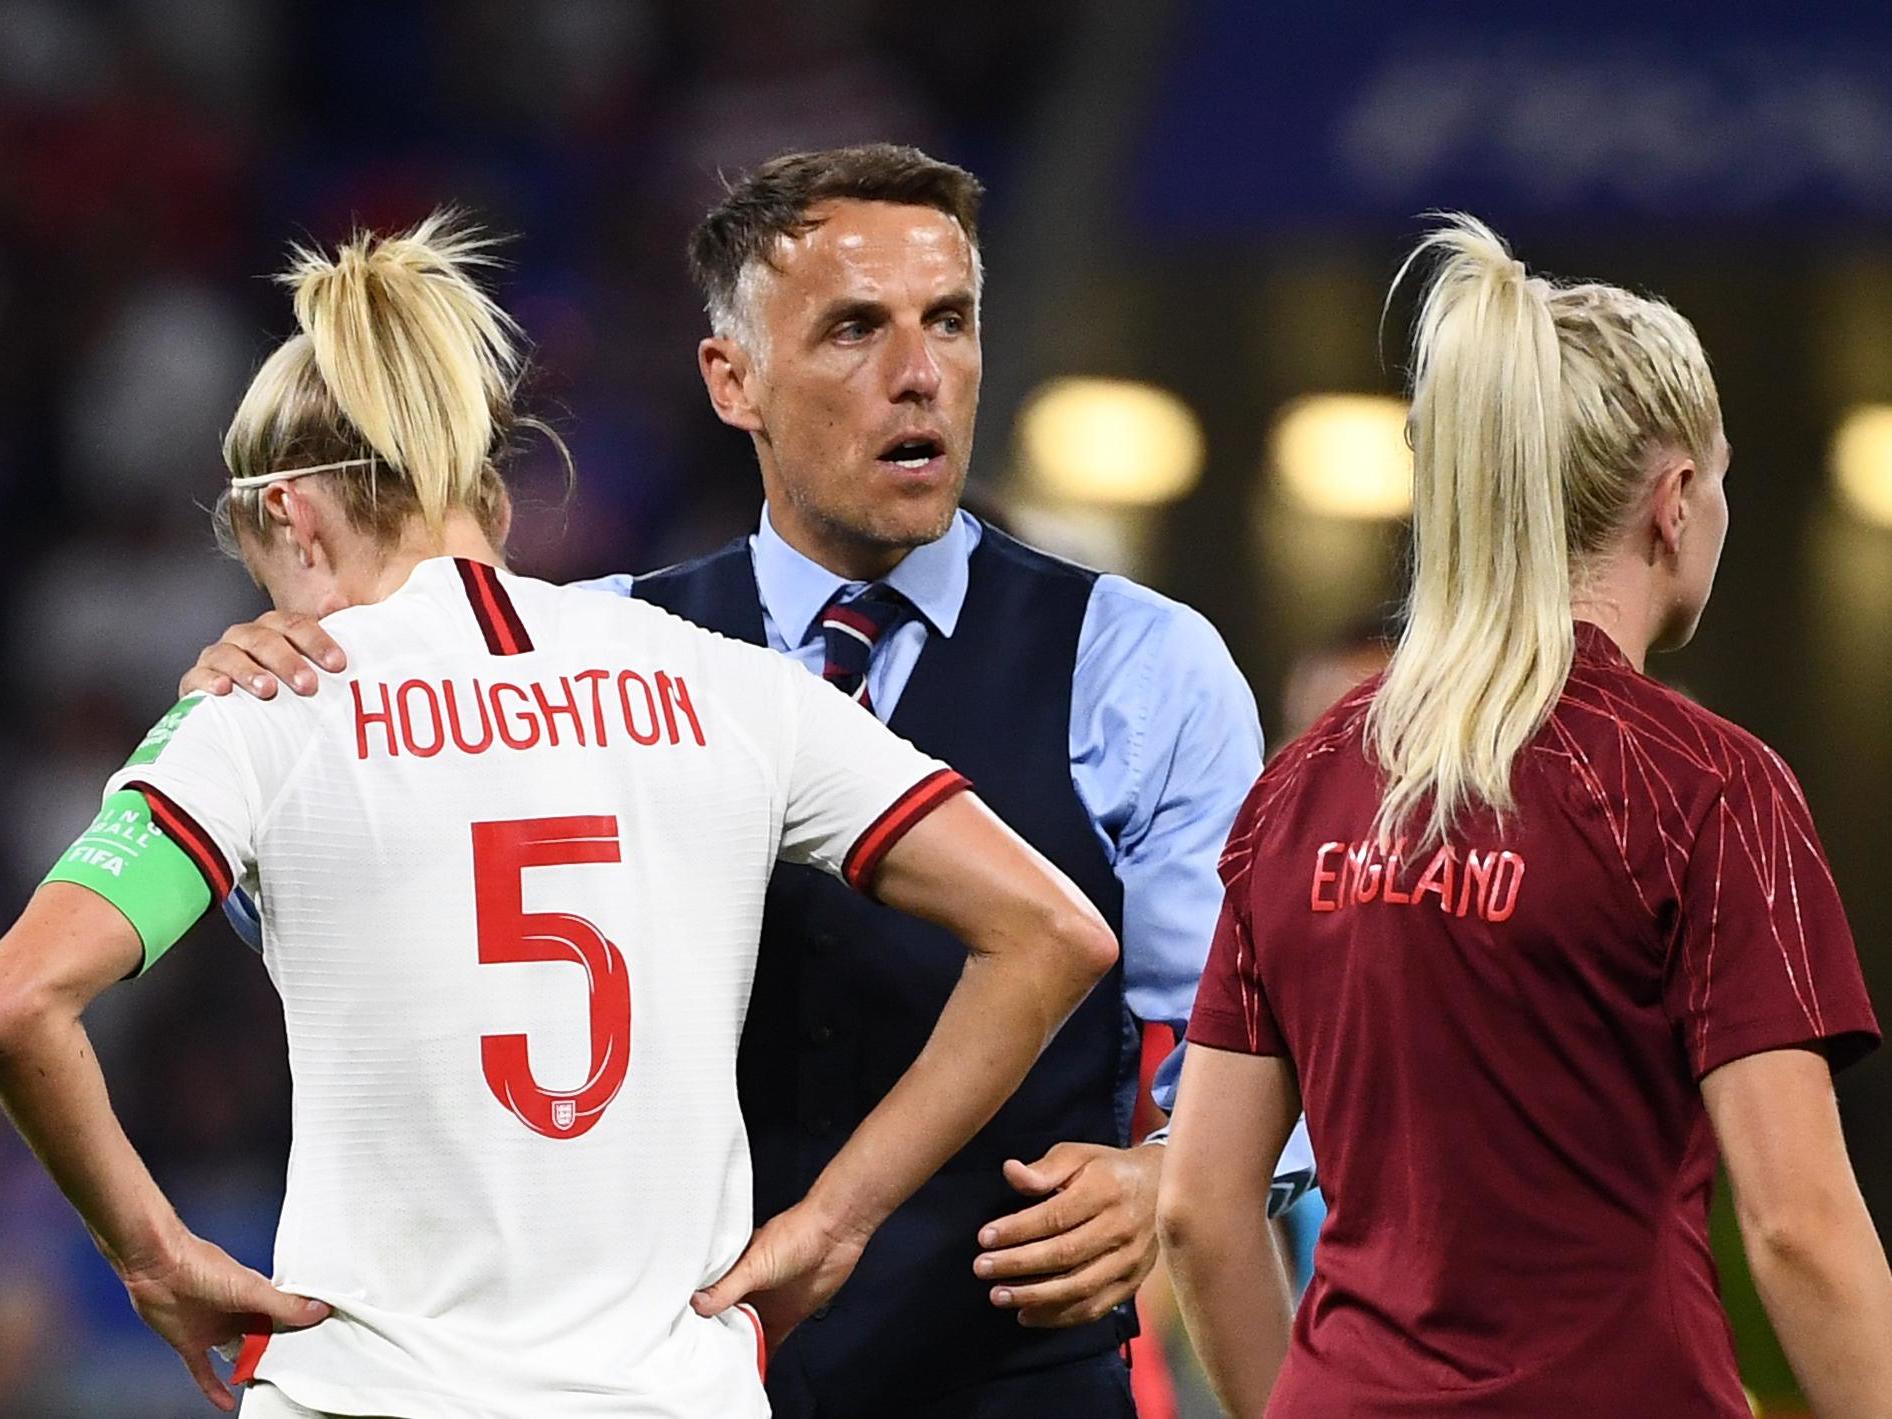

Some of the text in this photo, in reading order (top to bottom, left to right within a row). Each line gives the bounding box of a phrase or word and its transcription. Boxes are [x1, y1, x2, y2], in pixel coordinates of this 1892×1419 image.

[350, 669, 706, 760] HOUGHTON
[67, 846, 123, 877] FIFA
[1311, 836, 1525, 922] ENGLAND
[470, 815, 632, 1140] 5
